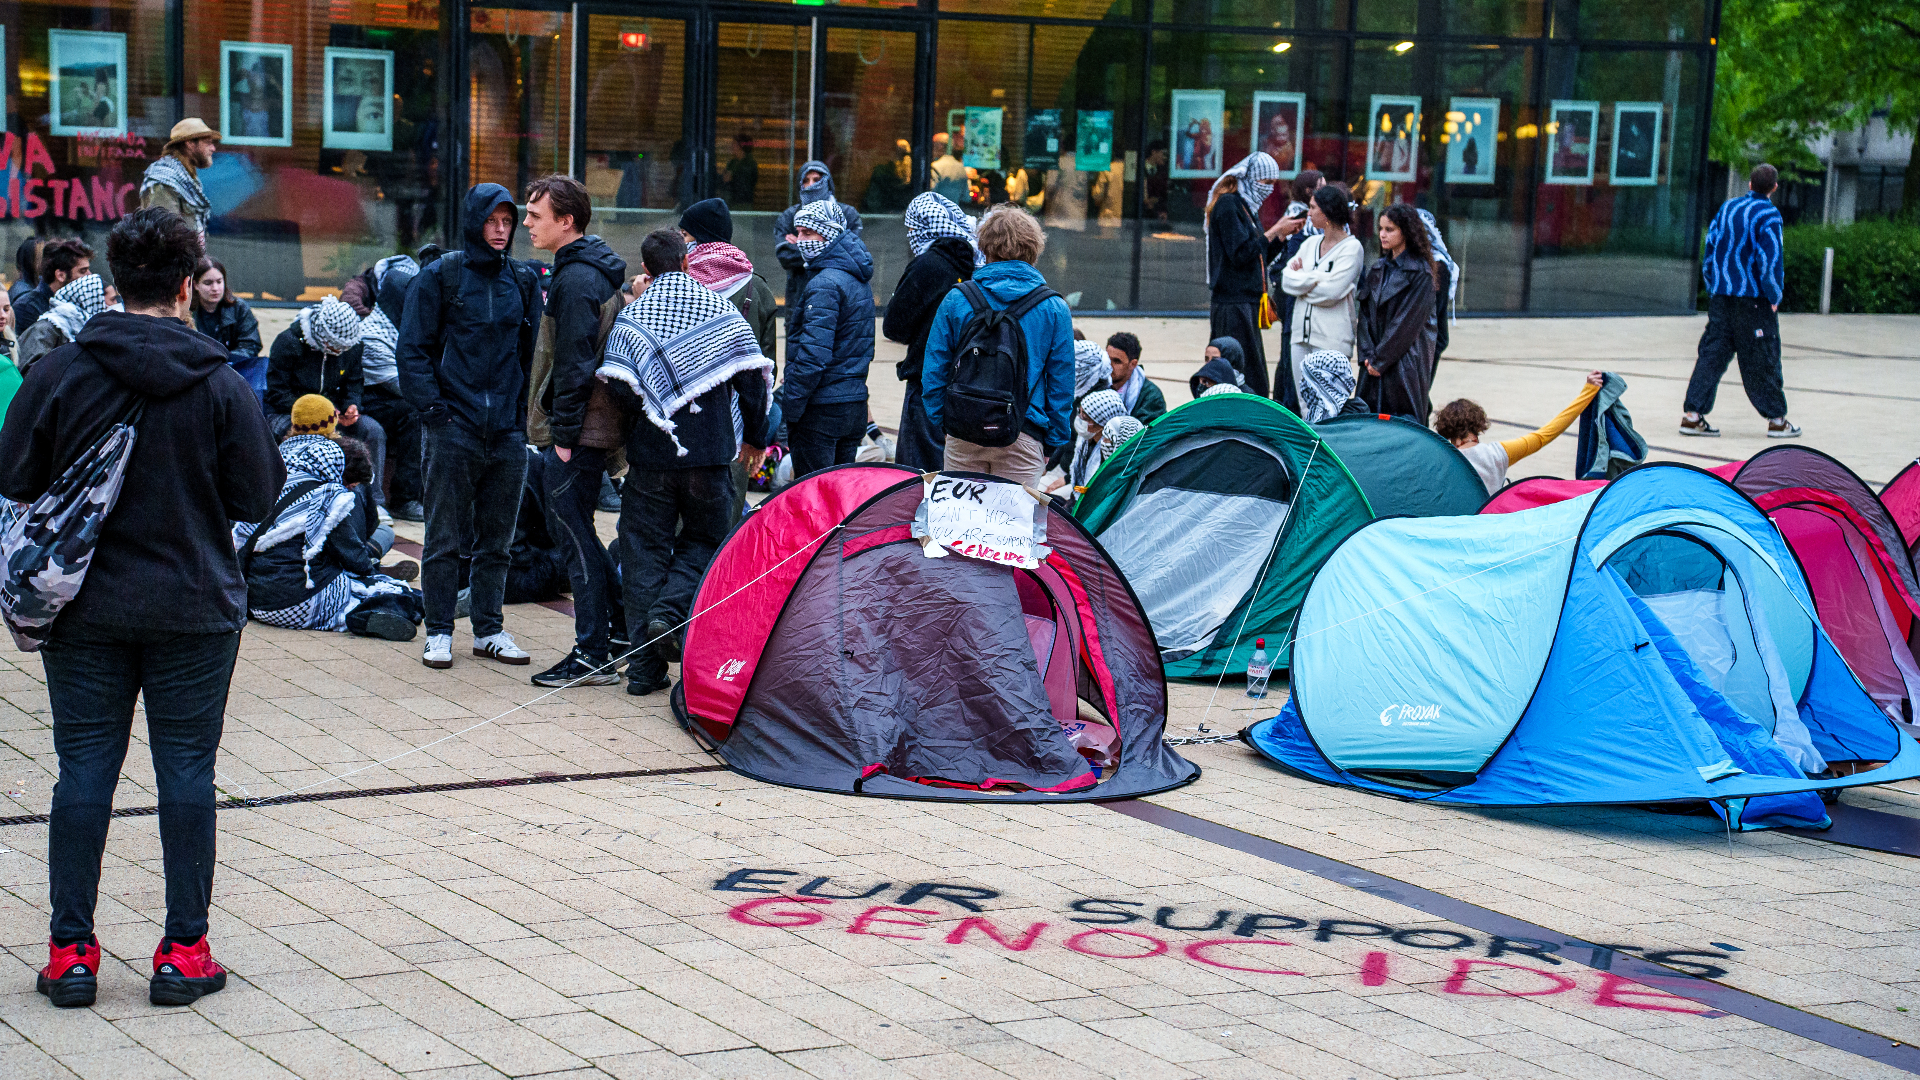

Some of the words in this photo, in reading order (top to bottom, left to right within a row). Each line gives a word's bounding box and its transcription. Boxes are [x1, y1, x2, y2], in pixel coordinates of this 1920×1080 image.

[930, 479, 987, 504] EUR
[992, 486, 1026, 507] YOU
[930, 506, 977, 523] CAN'T
[986, 508, 1023, 526] HIDE
[958, 527, 994, 543] ARE
[1398, 704, 1442, 720] FROYAK
[713, 868, 1000, 912] EUR
[728, 896, 1728, 1016] GENOCIDE
